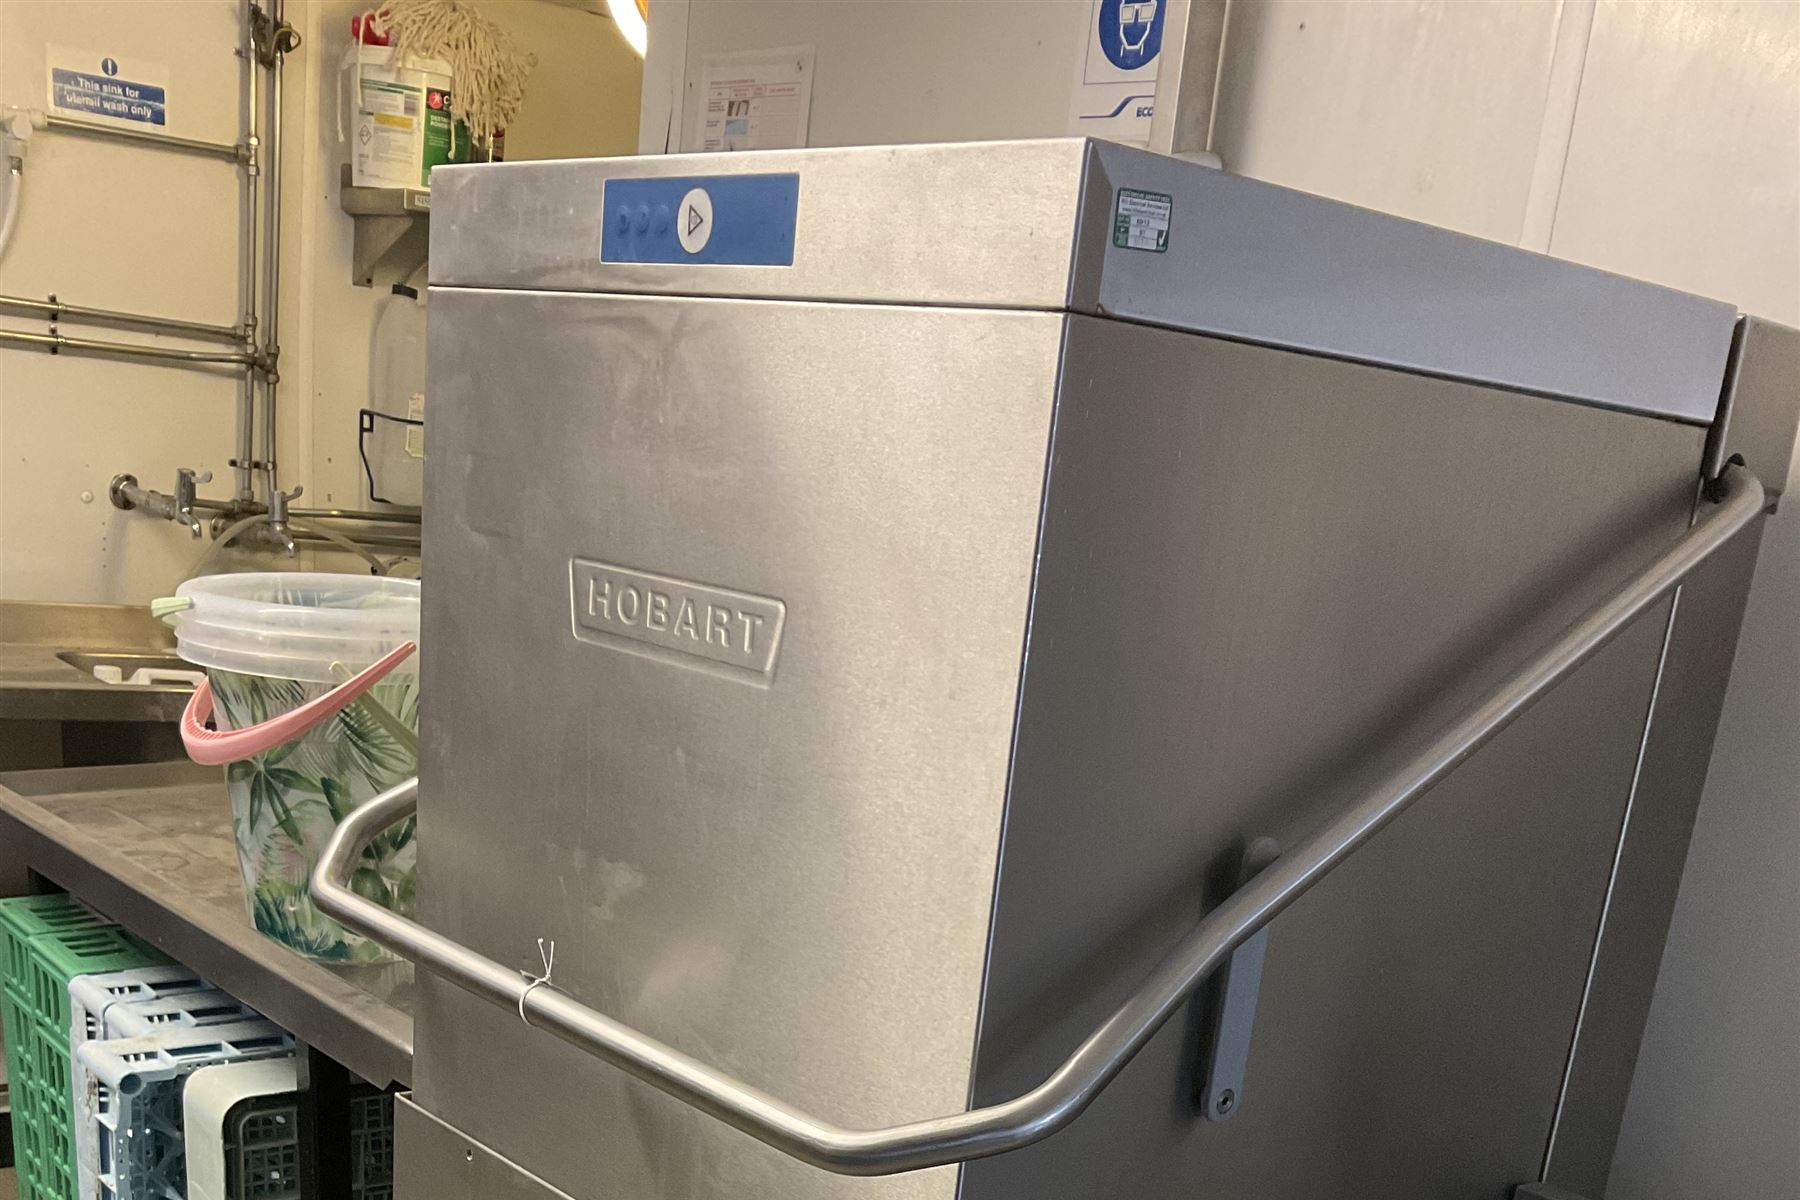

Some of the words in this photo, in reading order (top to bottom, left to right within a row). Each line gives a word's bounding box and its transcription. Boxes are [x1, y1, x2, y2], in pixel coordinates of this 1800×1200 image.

[77, 76, 100, 91] This
[102, 83, 123, 96] sink
[126, 87, 140, 98] for
[103, 99, 129, 112] wash
[131, 104, 152, 118] only
[588, 577, 765, 653] HOBART
